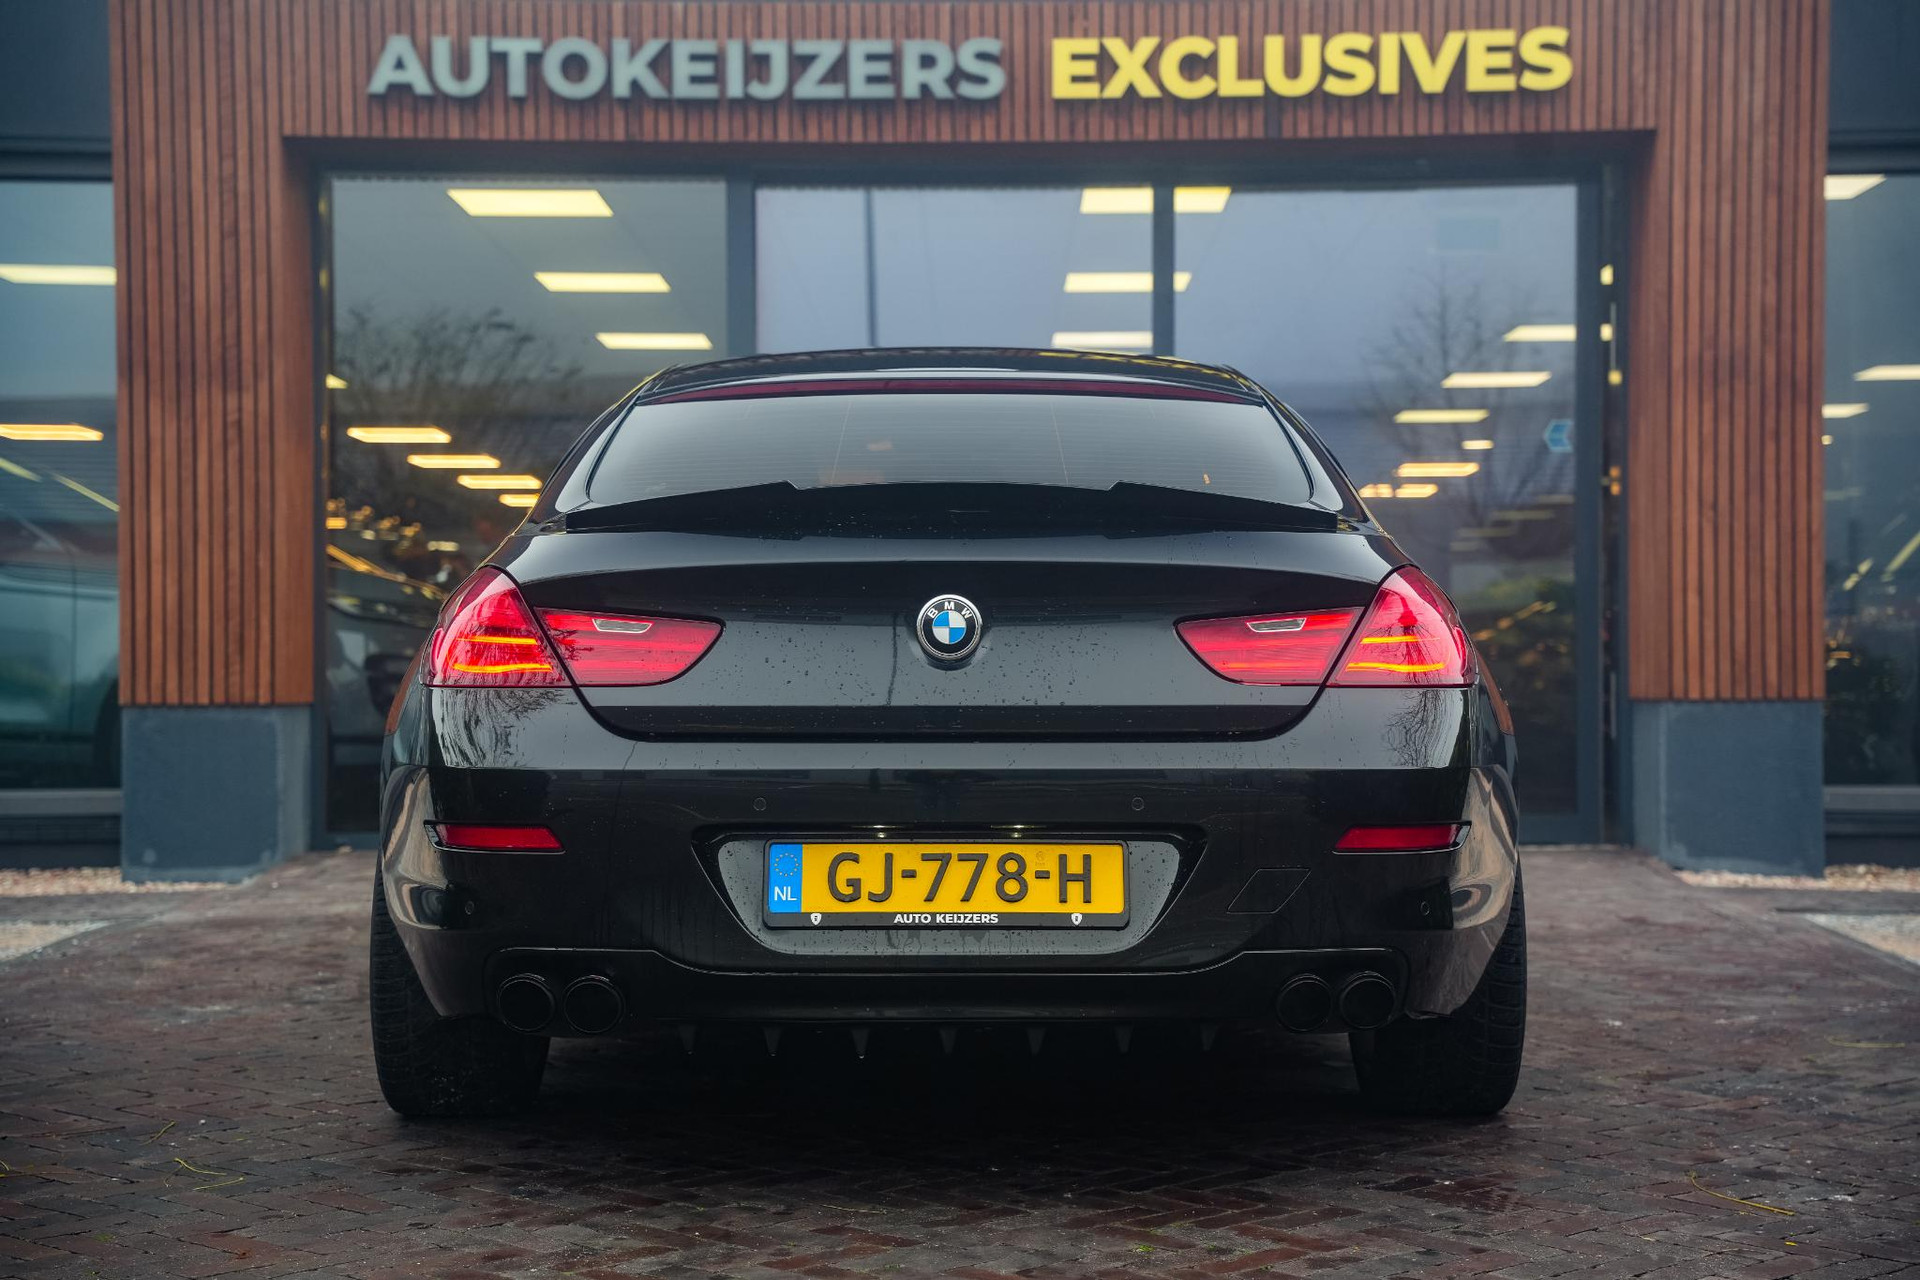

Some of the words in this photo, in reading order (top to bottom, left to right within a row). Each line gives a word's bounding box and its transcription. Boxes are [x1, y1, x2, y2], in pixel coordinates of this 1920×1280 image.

[367, 34, 1008, 100] AUTOKEIJZERS
[1051, 26, 1573, 100] EXCLUSIVES
[927, 601, 973, 619] BMW
[827, 852, 1092, 903] GJ-778-H
[774, 886, 797, 901] NL
[893, 913, 931, 924] AUTO
[936, 913, 999, 924] KEIJZERS
